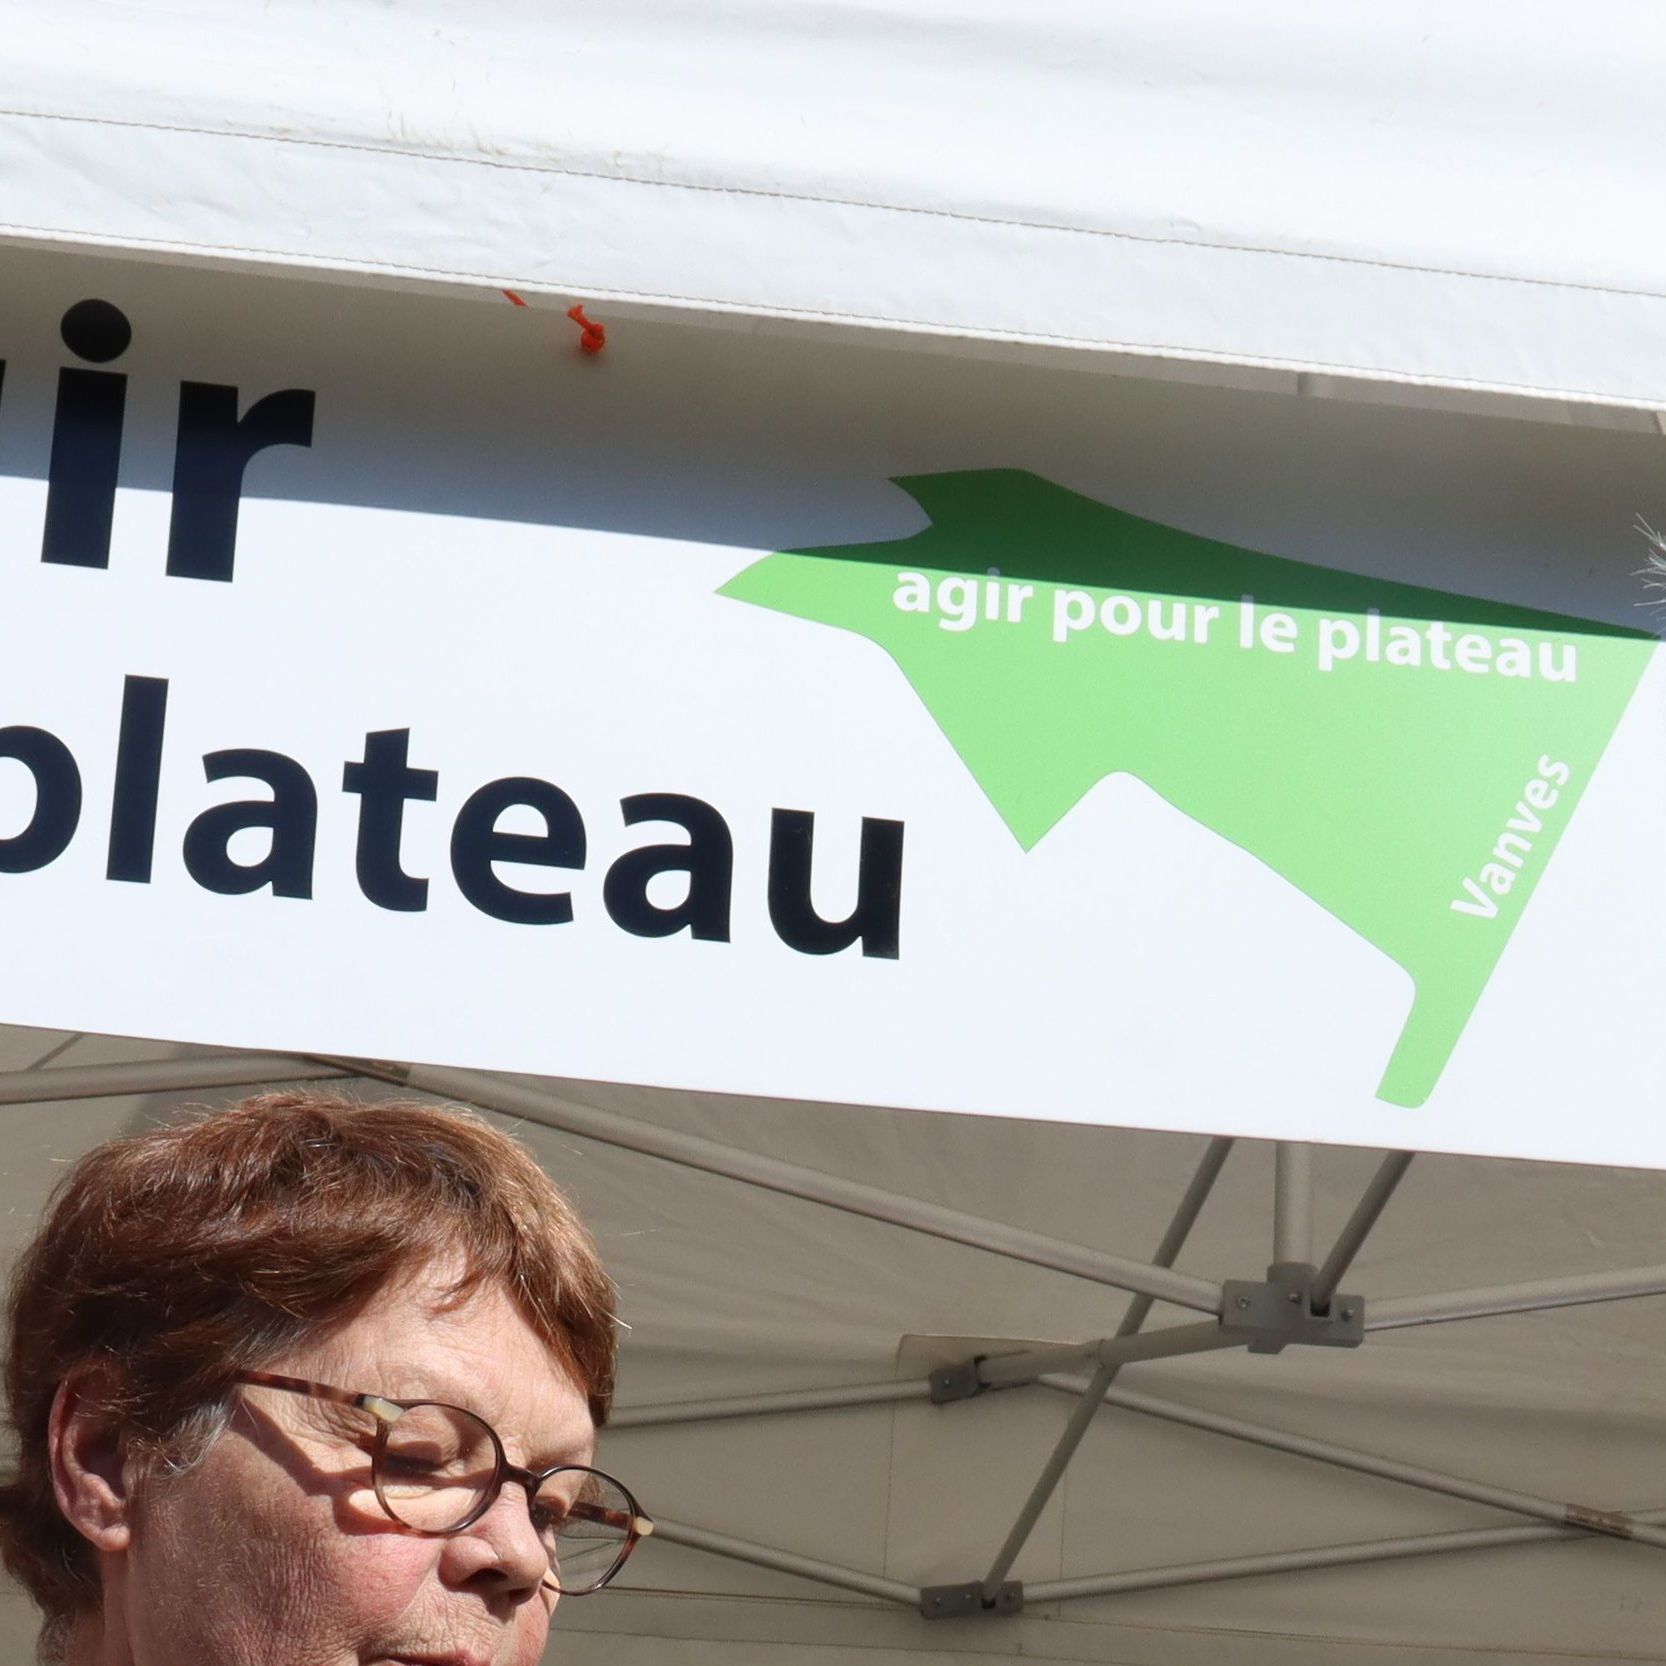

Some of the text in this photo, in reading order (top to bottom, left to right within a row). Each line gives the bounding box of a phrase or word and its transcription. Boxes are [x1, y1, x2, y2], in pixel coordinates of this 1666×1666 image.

[892, 566, 1578, 684] agir pour le plateau
[1449, 751, 1573, 921] Vanves
